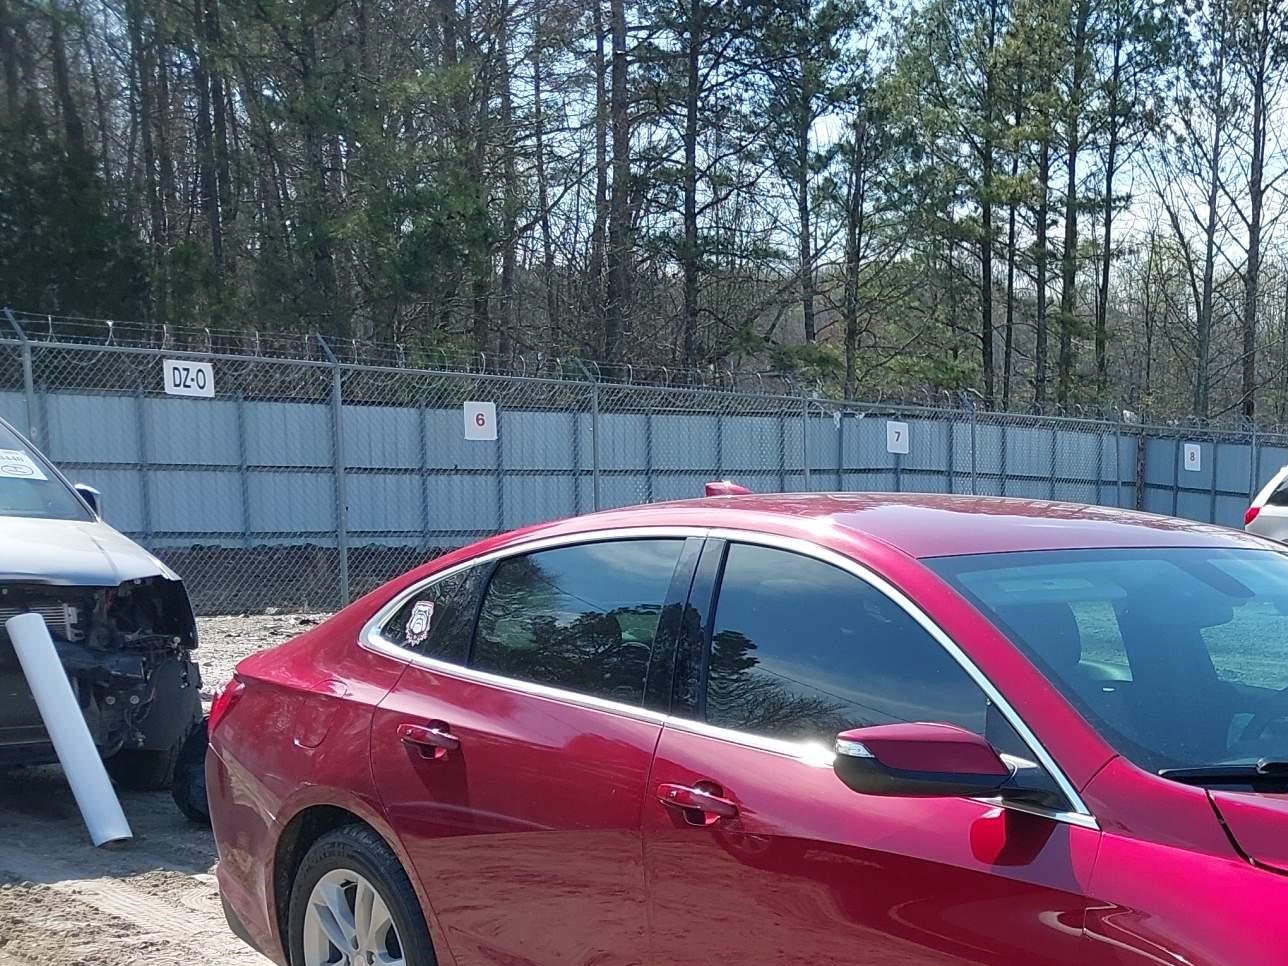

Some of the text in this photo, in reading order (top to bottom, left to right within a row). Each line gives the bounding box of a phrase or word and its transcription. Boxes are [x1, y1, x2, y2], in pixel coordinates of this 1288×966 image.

[475, 412, 486, 427] 6
[894, 431, 901, 442] 7
[1190, 451, 1196, 462] 8
